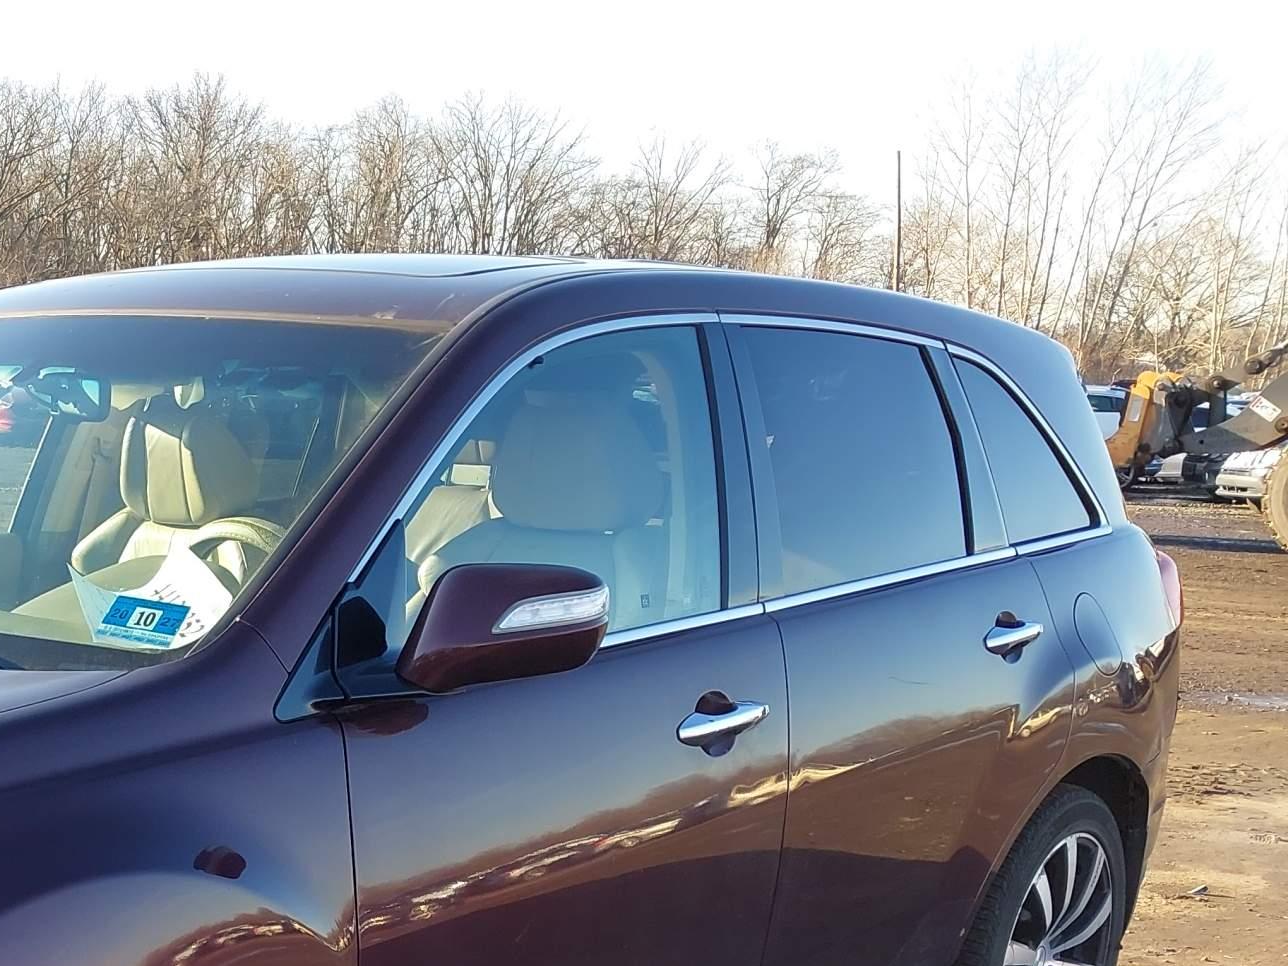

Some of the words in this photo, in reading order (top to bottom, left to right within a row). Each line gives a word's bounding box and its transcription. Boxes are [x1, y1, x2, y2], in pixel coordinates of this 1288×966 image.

[111, 608, 130, 620] 20
[133, 611, 157, 627] 10
[160, 616, 179, 628] 27
